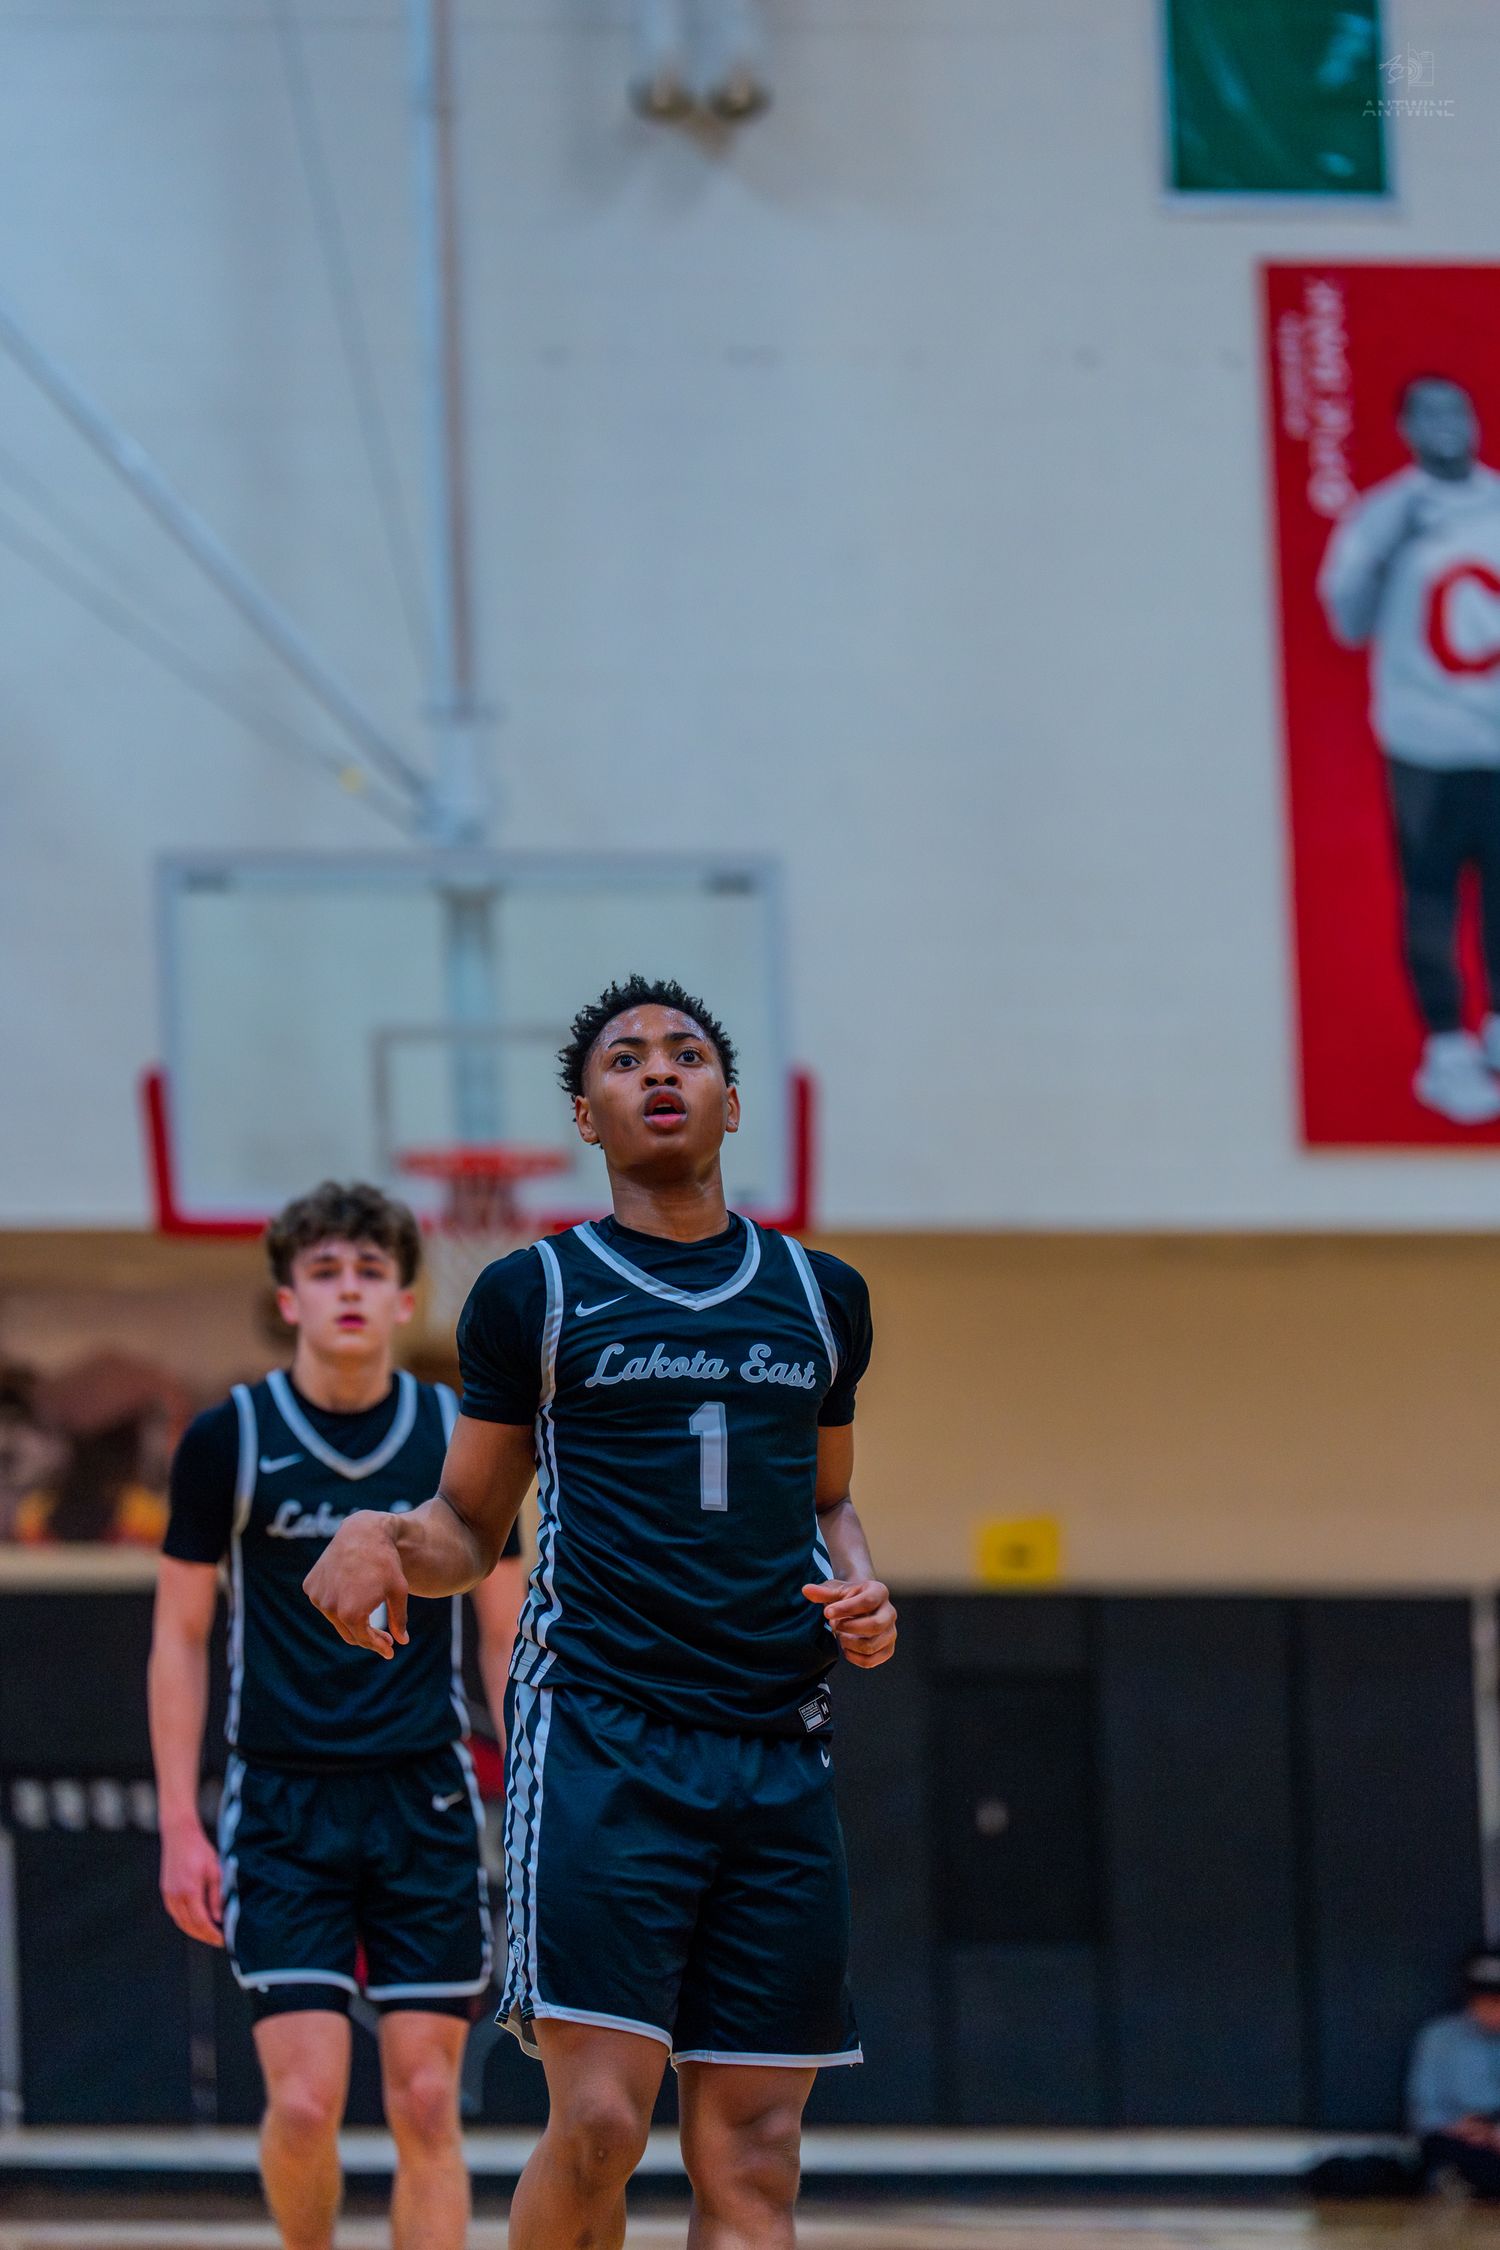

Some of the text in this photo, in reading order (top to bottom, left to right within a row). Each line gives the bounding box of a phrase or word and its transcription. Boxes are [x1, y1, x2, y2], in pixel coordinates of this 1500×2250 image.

[585, 1343, 816, 1389] Lakota East
[689, 1401, 728, 1512] 1
